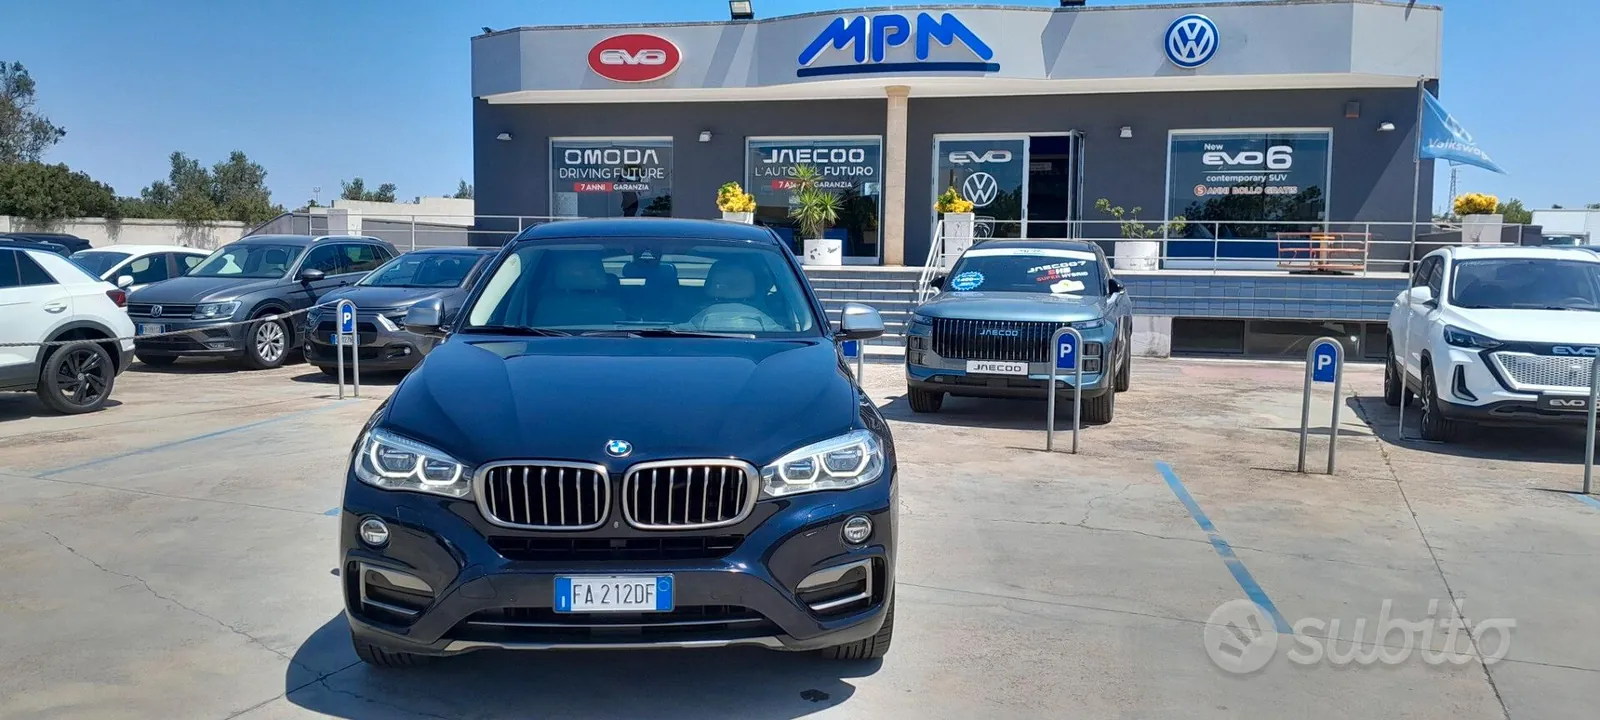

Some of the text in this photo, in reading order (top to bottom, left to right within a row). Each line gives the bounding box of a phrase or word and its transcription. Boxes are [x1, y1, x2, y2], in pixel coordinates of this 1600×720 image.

[798, 12, 994, 66] MPM
[600, 49, 666, 65] EVO
[1204, 143, 1223, 151] New
[564, 149, 659, 165] OMODA
[763, 148, 865, 163] JAECOO
[948, 150, 1012, 163] EVO
[559, 167, 665, 179] DRIVING FUTURE
[824, 166, 874, 176] FUTURO
[1206, 174, 1288, 183] contemporary SUV
[586, 183, 606, 191] ANNI
[613, 183, 650, 191] GARANZIA
[343, 312, 352, 325] P
[979, 329, 1019, 337] JAECOO
[1060, 343, 1073, 358] P
[973, 364, 1022, 372] JAECOO
[1317, 354, 1332, 370] P
[1549, 399, 1586, 407] EVO
